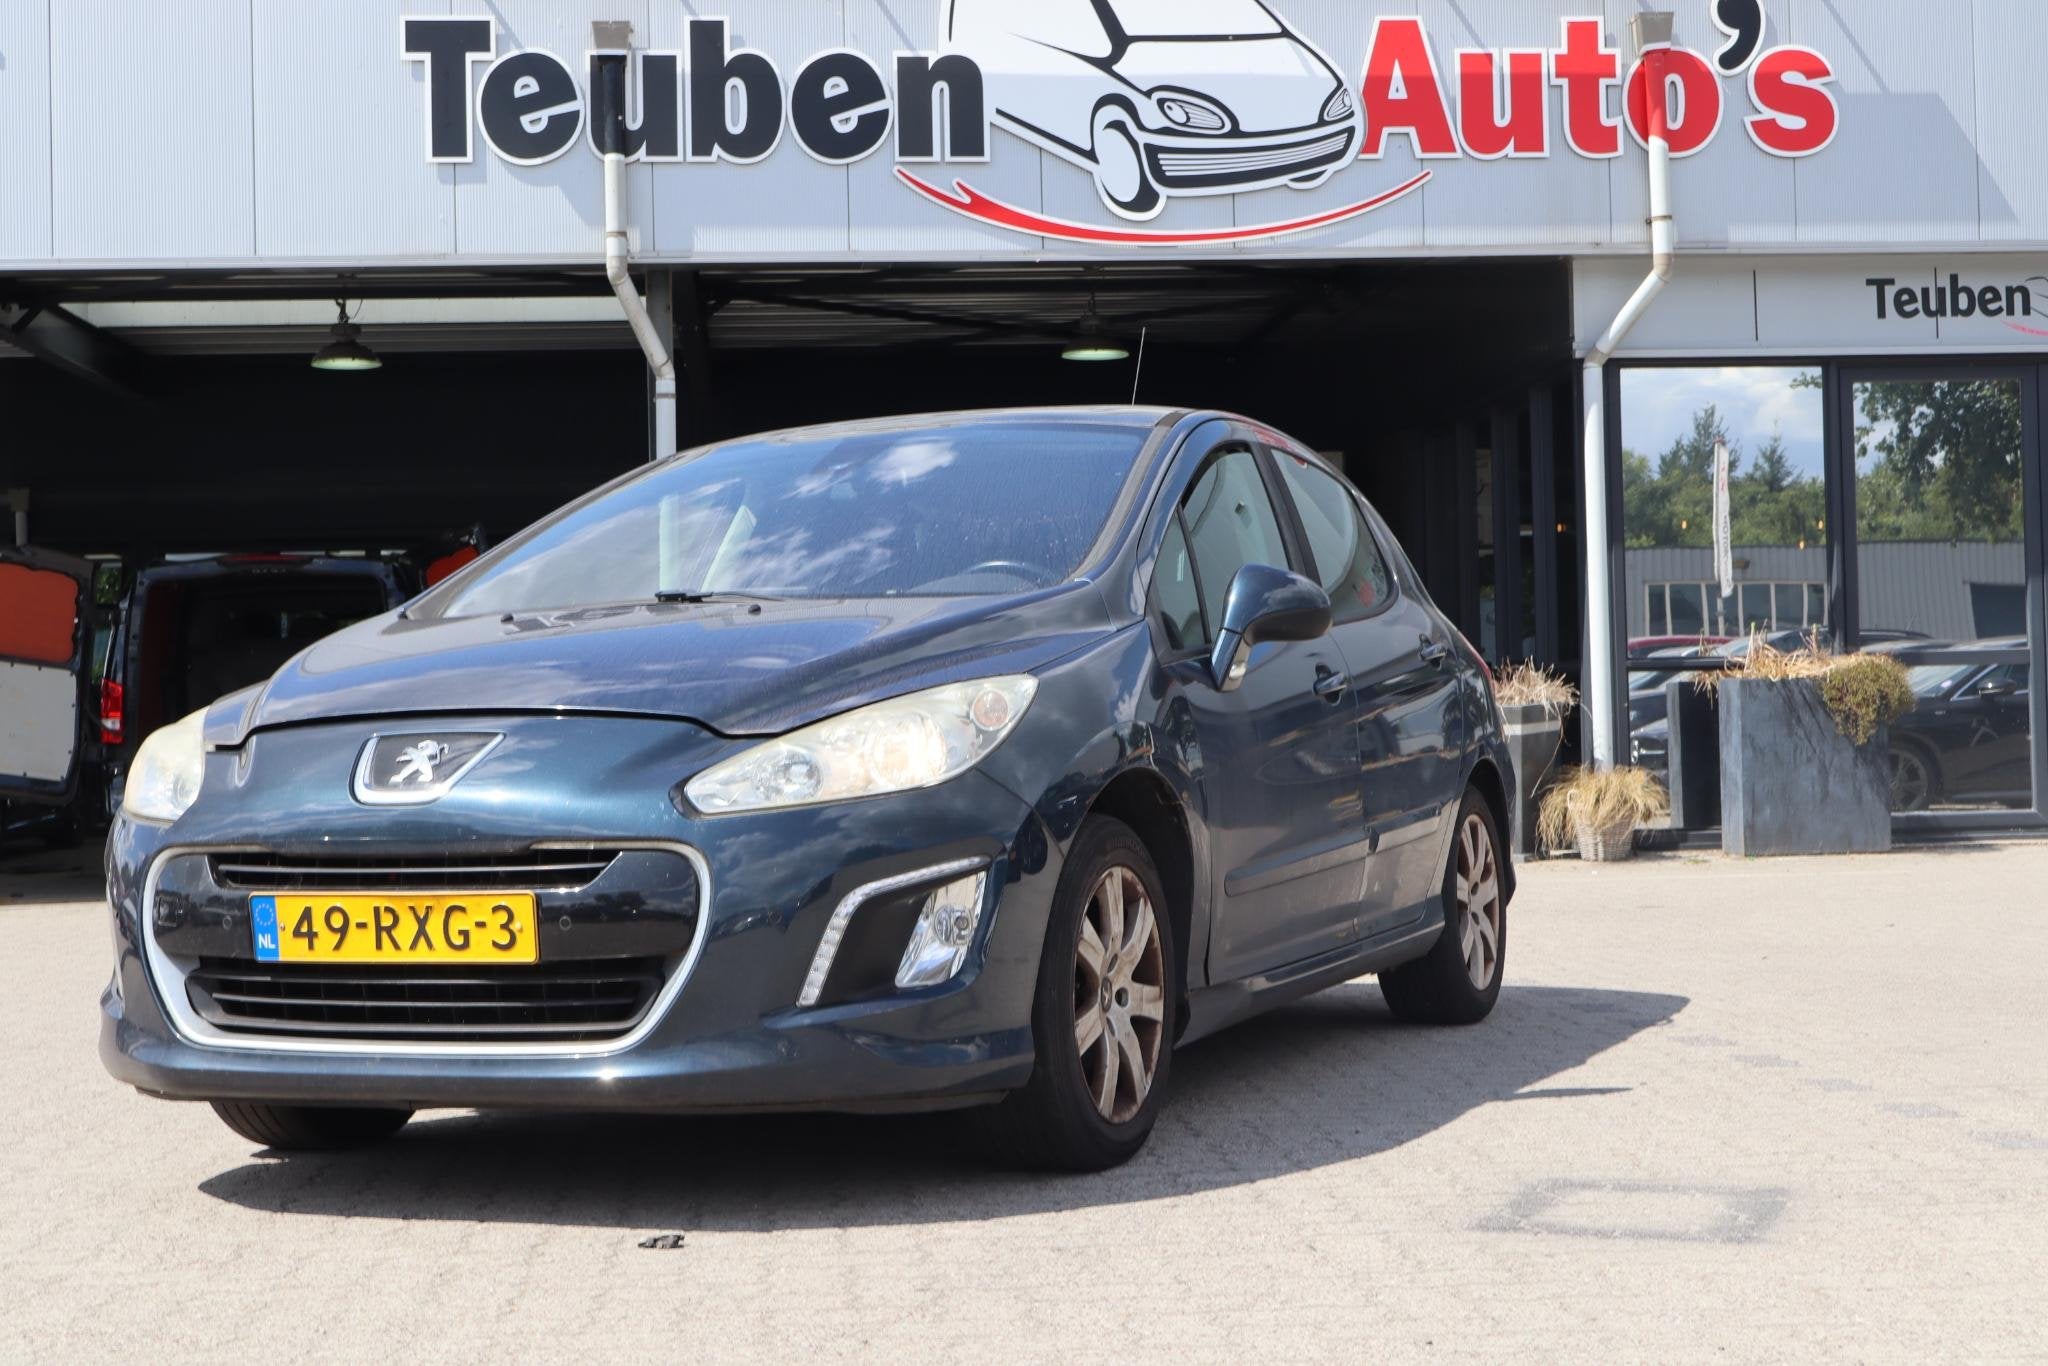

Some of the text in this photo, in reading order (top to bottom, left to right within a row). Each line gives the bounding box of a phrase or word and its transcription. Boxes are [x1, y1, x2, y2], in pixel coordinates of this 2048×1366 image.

[404, 0, 1837, 162] Teuben Auto's
[1865, 273, 2031, 320] Teuben
[257, 933, 276, 949] NL
[291, 904, 518, 952] 49-RXG-3
